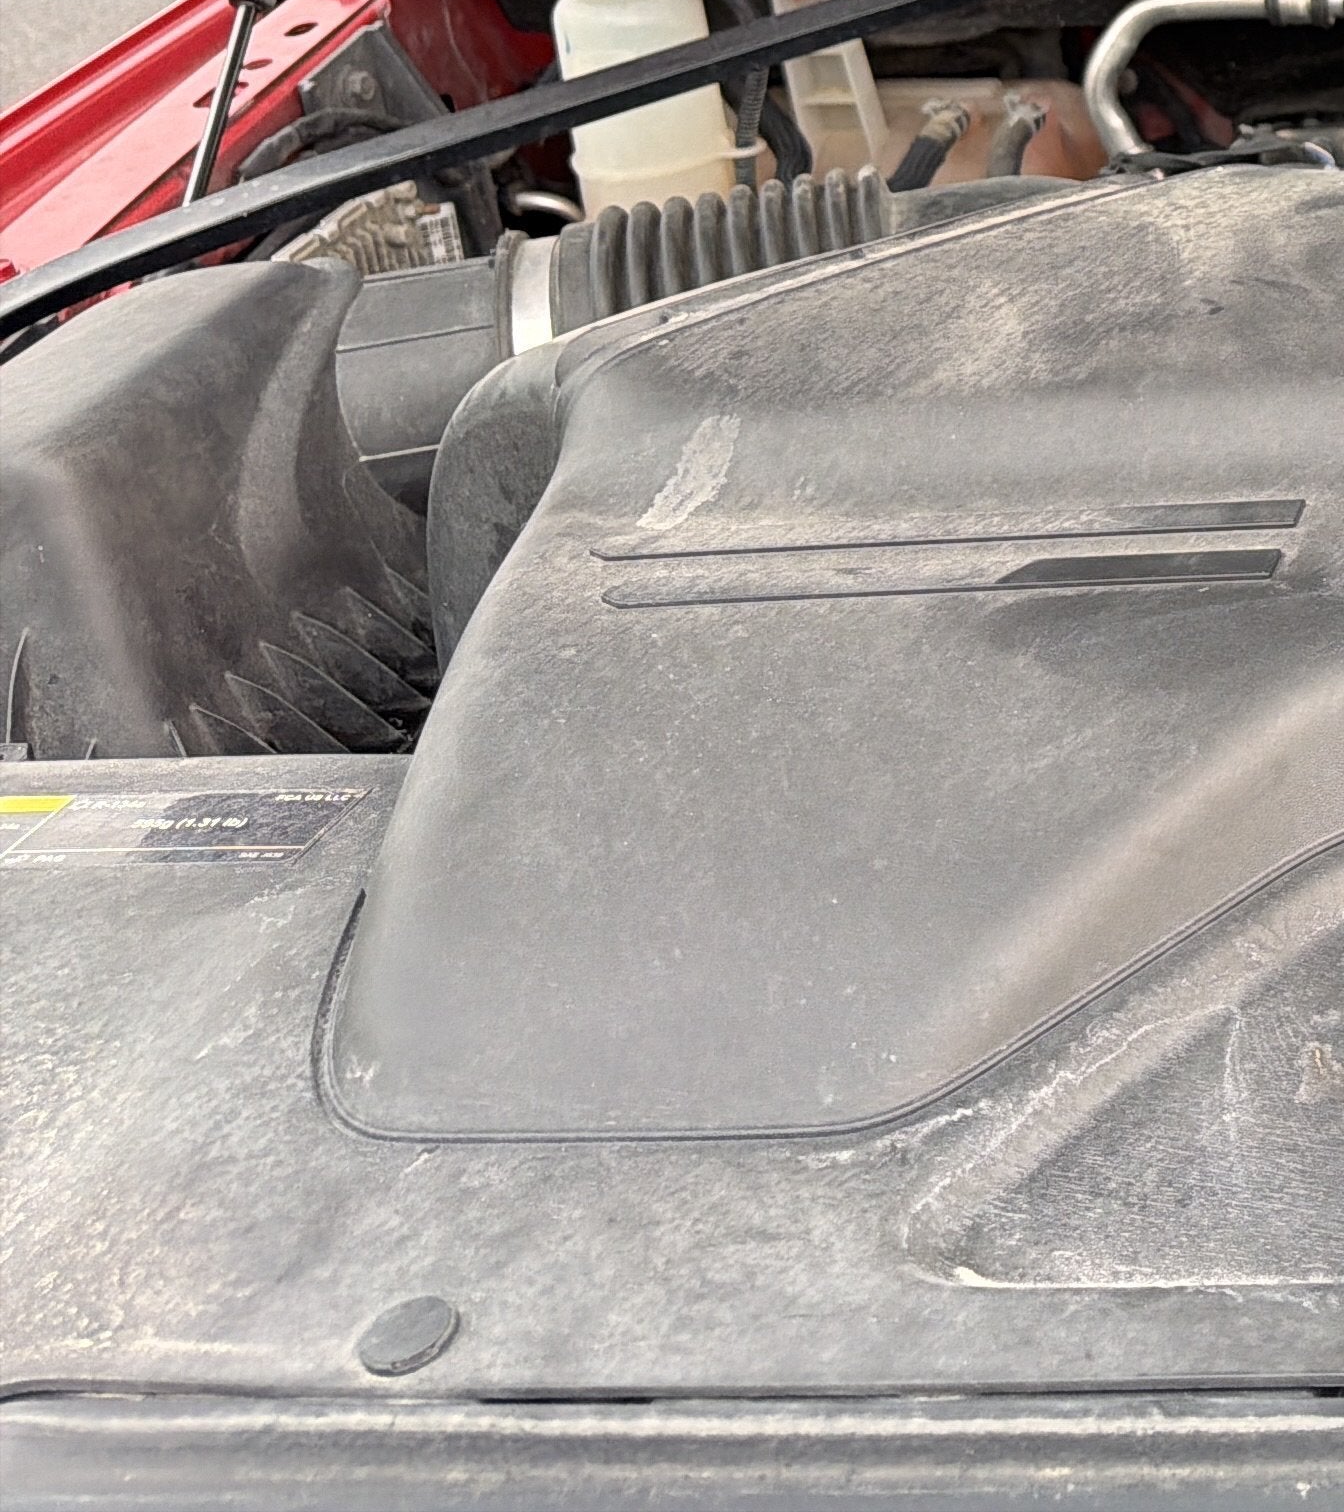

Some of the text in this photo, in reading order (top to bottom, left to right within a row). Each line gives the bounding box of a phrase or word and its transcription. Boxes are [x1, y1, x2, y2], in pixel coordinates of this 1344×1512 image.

[324, 793, 351, 802] LLC
[175, 817, 221, 830] (1.31
[221, 817, 249, 829] lb)
